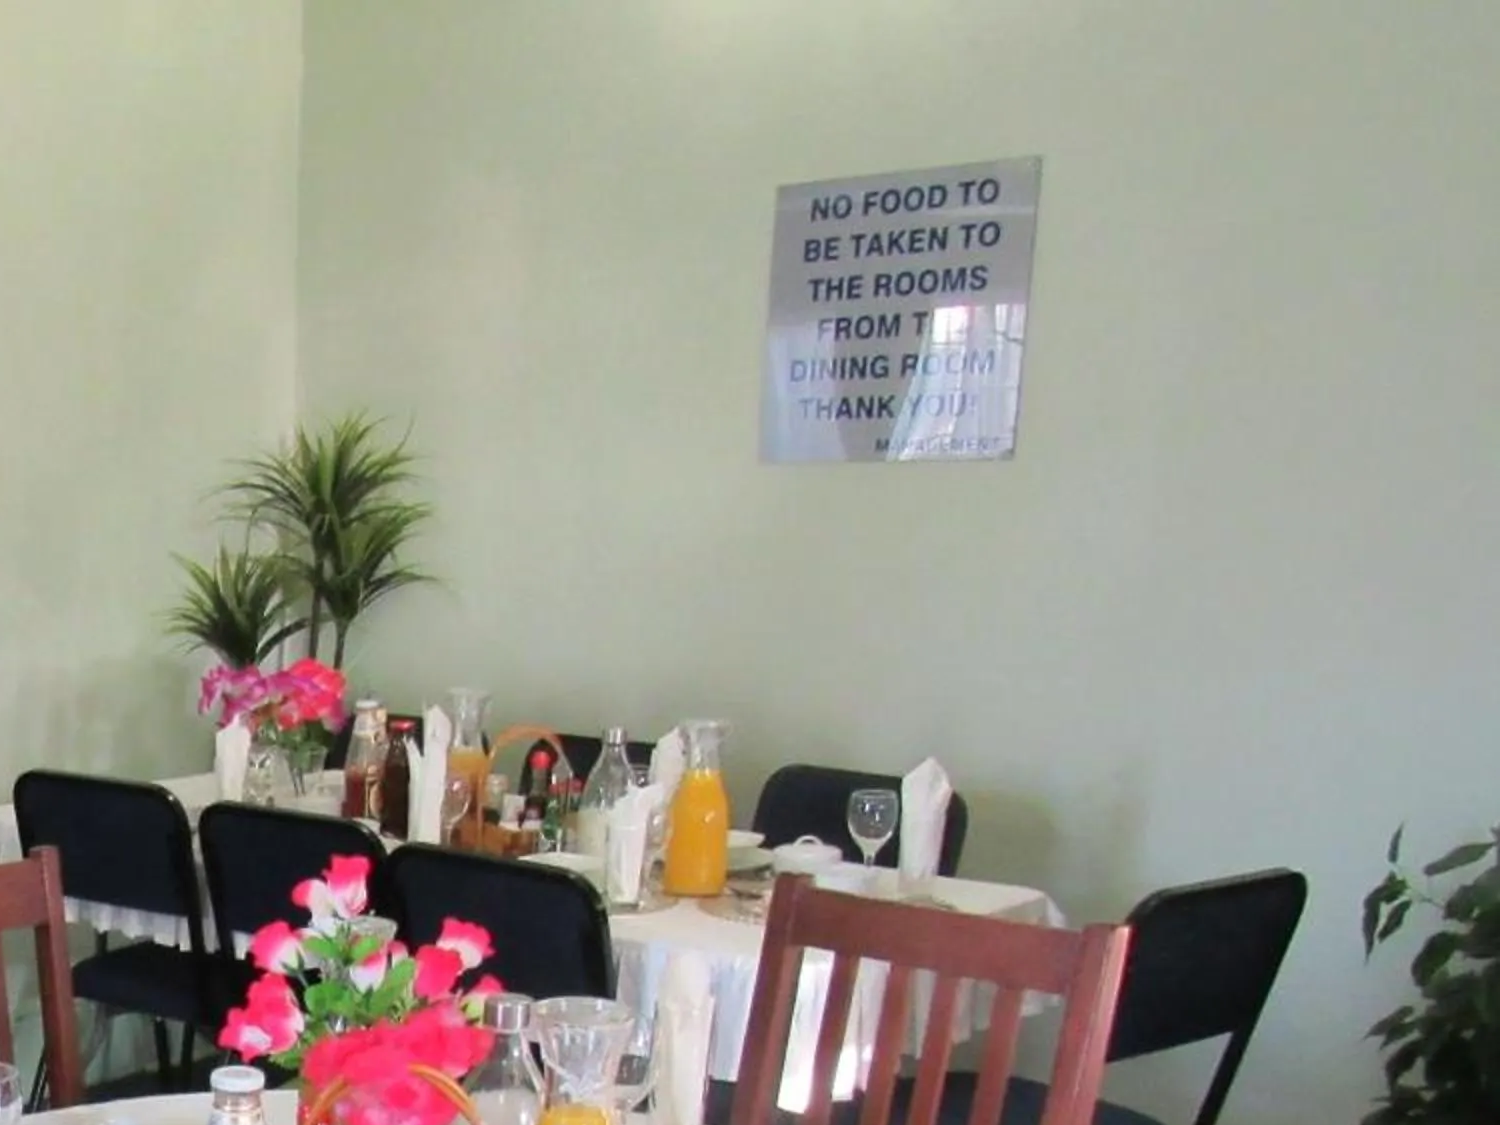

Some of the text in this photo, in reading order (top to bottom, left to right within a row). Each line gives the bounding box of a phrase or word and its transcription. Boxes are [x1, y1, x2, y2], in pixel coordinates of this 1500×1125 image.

[810, 178, 1001, 222] NO FOOD TO
[803, 221, 1002, 263] BE TAKEN TO
[808, 265, 989, 302] THE ROOMS
[817, 313, 902, 342] FROM
[790, 350, 996, 382] DINING ROOM
[800, 396, 896, 420] THANK
